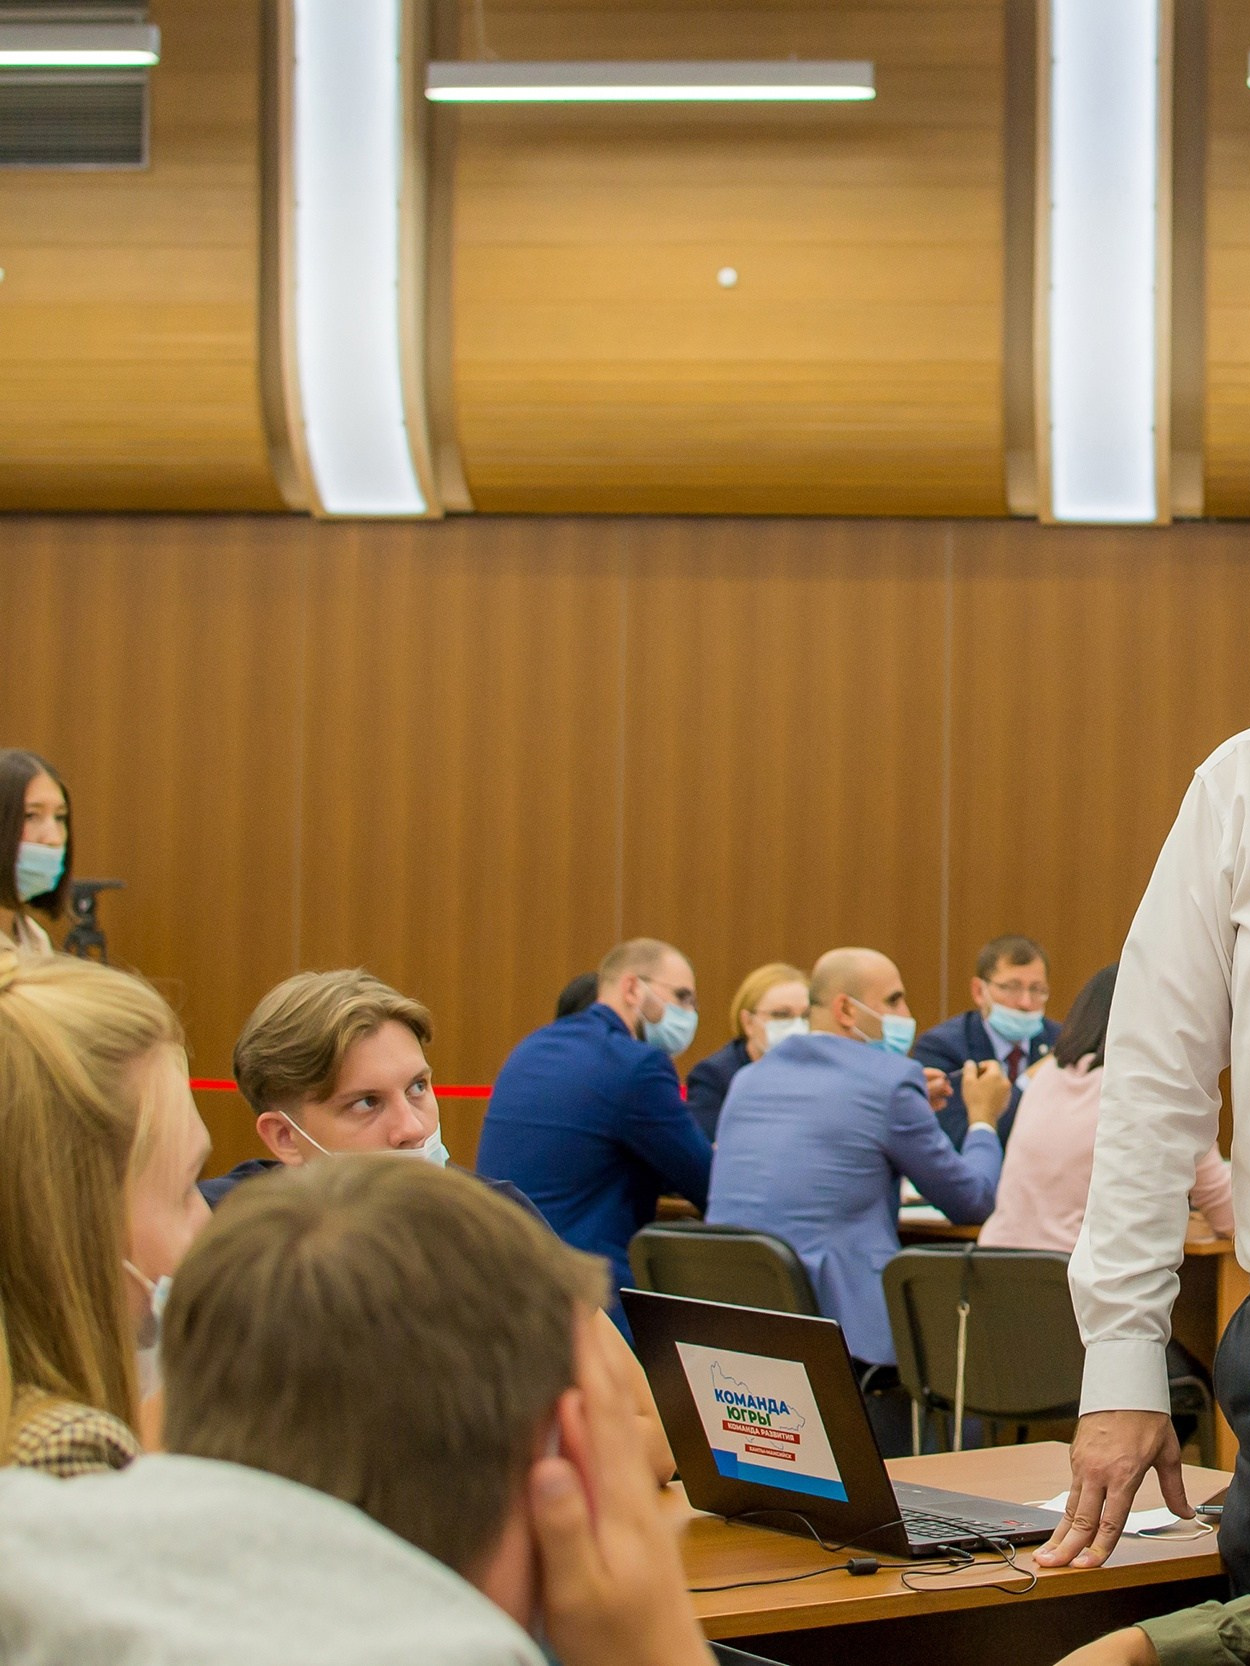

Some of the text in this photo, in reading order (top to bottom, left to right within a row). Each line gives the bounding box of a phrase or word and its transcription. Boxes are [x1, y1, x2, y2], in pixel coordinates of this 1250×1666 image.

[714, 1388, 790, 1415] КОМАНДА
[727, 1406, 772, 1426] ЮГРЫ
[727, 1422, 795, 1441] КОМАНДА РАЗВИТИЯ
